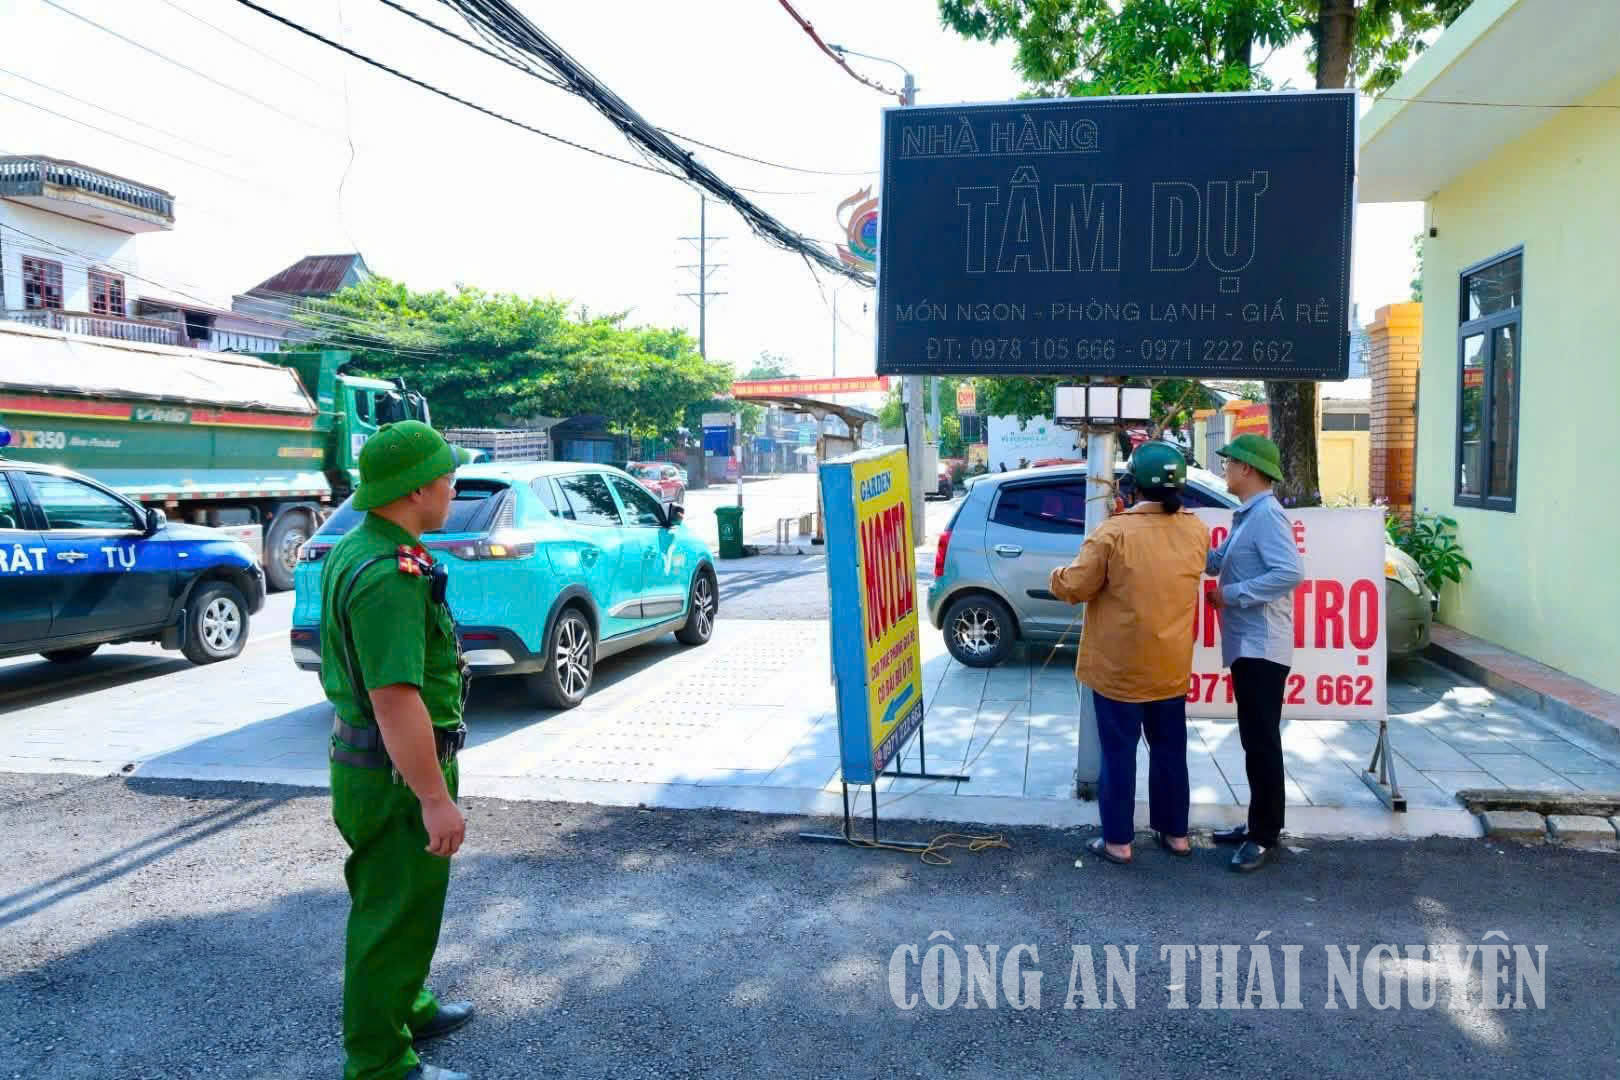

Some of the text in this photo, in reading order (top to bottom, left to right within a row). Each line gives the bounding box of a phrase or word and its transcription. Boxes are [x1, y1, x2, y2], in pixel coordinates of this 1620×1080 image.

[900, 113, 1101, 155] NHÀ HÀNG
[957, 165, 1269, 293] TÂM DỰ
[896, 299, 948, 322] MÓN
[957, 302, 1027, 322] NGON
[1051, 298, 1140, 322] PHÒNG
[1150, 302, 1217, 323] LẠNH
[1241, 299, 1286, 322] GIÁ
[1295, 298, 1330, 323] RẺ
[925, 337, 962, 360] ĐT:
[970, 337, 1022, 360] 0978
[1030, 338, 1069, 360] 105
[1077, 338, 1116, 360] 666
[1140, 338, 1193, 361] 0971
[1203, 339, 1246, 362] 222
[1252, 339, 1296, 362] 662
[860, 472, 891, 502] GARDEN
[101, 543, 136, 572] TỰ
[1292, 579, 1379, 666] TRỌ
[1185, 673, 1235, 704] 971
[1315, 674, 1374, 706] 662
